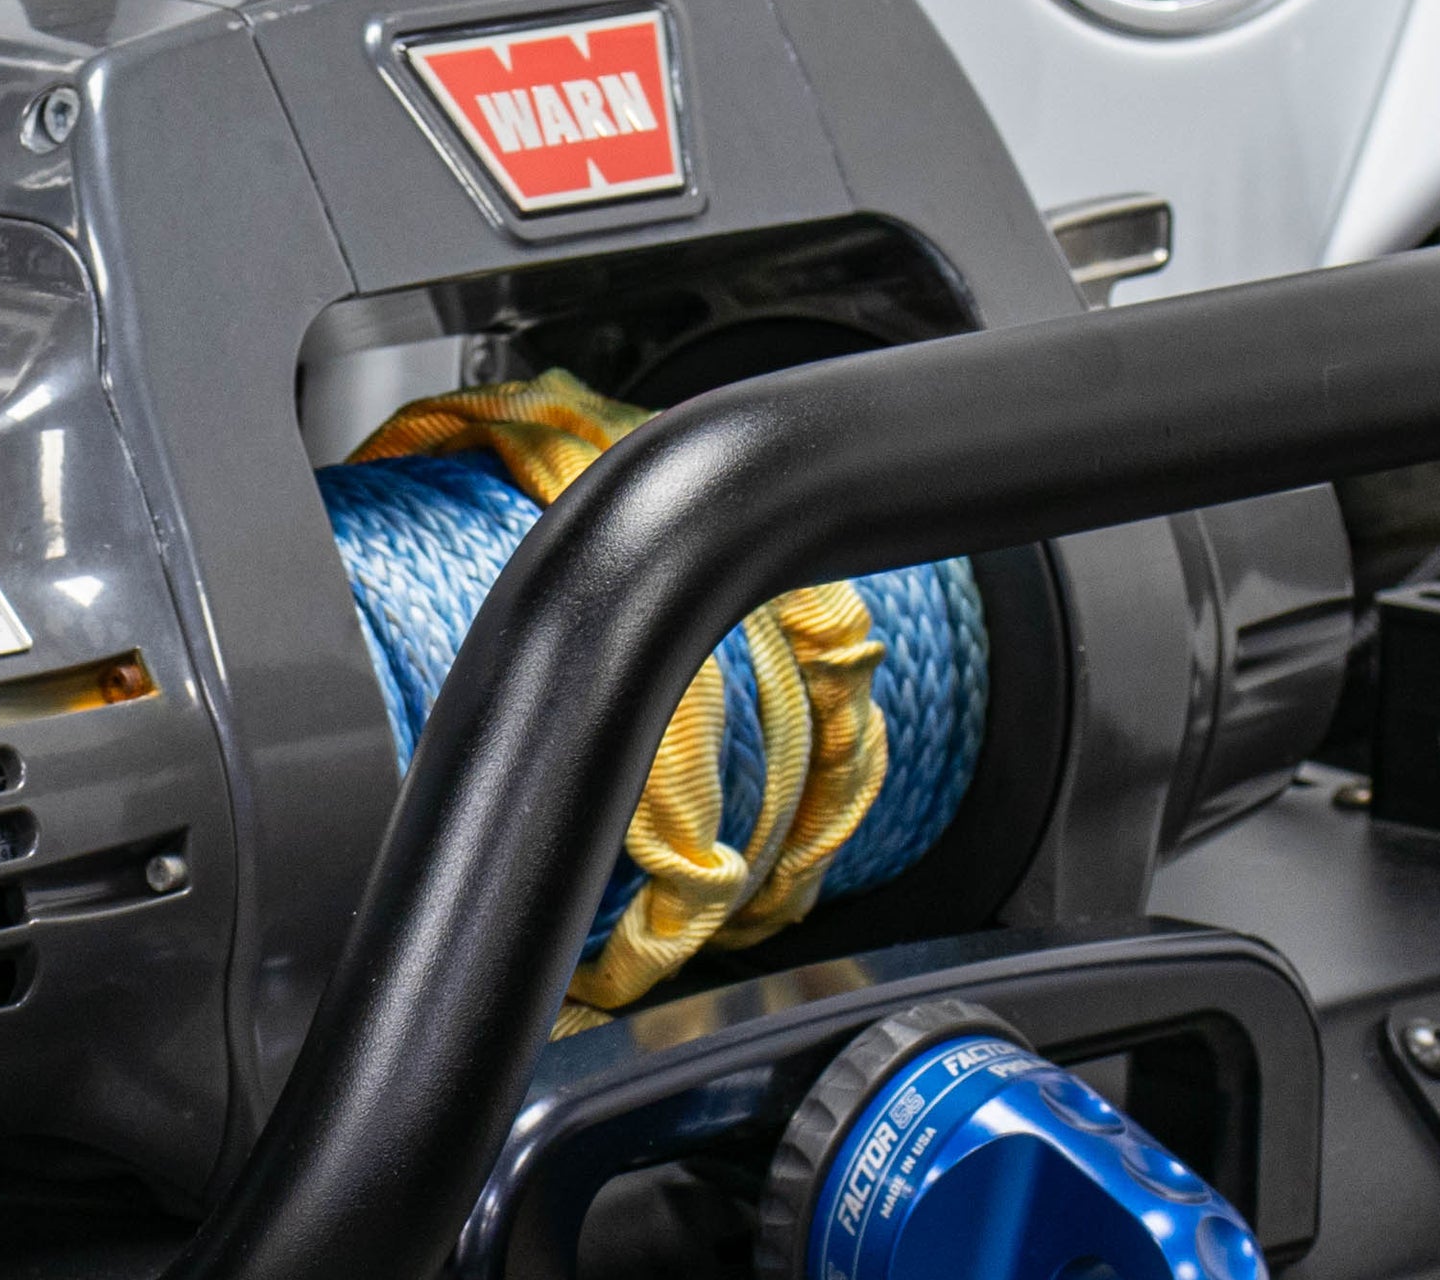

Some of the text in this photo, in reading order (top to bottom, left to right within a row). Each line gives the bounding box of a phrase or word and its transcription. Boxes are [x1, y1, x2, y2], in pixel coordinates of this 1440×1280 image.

[475, 72, 658, 153] WARN
[837, 1121, 899, 1237] FACTOR
[880, 1126, 938, 1219] MADE IN USA
